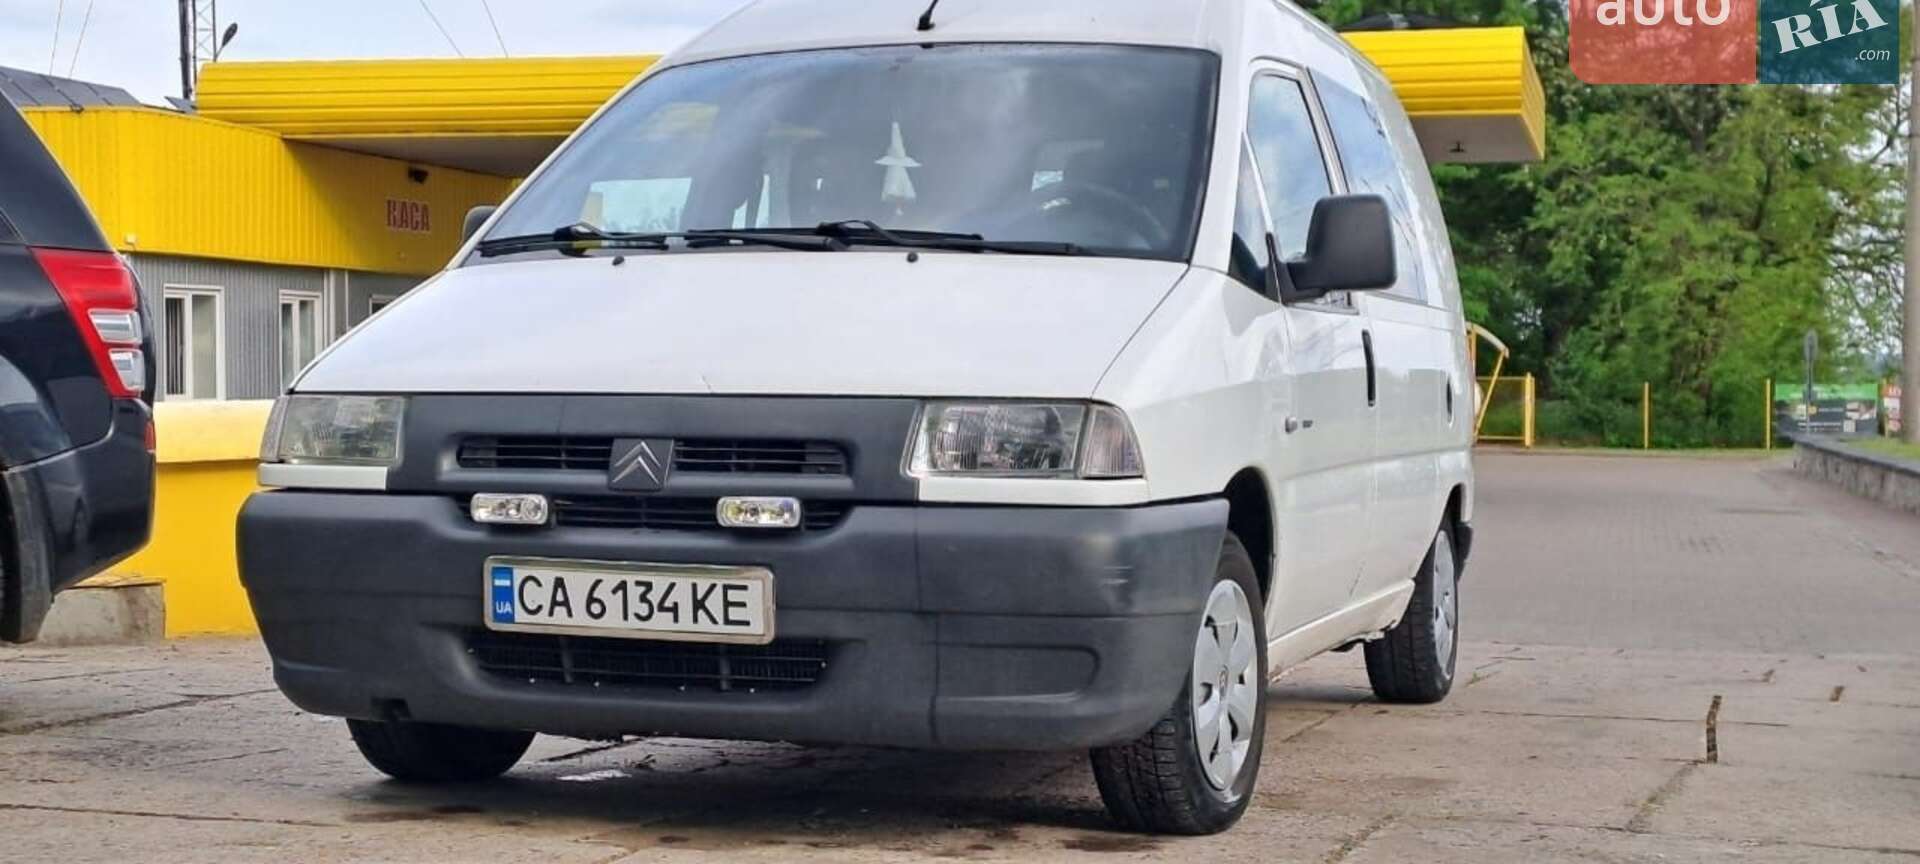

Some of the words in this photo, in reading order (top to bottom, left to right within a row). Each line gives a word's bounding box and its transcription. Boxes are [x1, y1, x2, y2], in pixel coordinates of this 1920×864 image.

[386, 199, 431, 232] КАСА
[495, 603, 513, 615] UA
[517, 574, 574, 619] CA
[584, 578, 680, 623] 6134
[691, 582, 751, 627] KE
